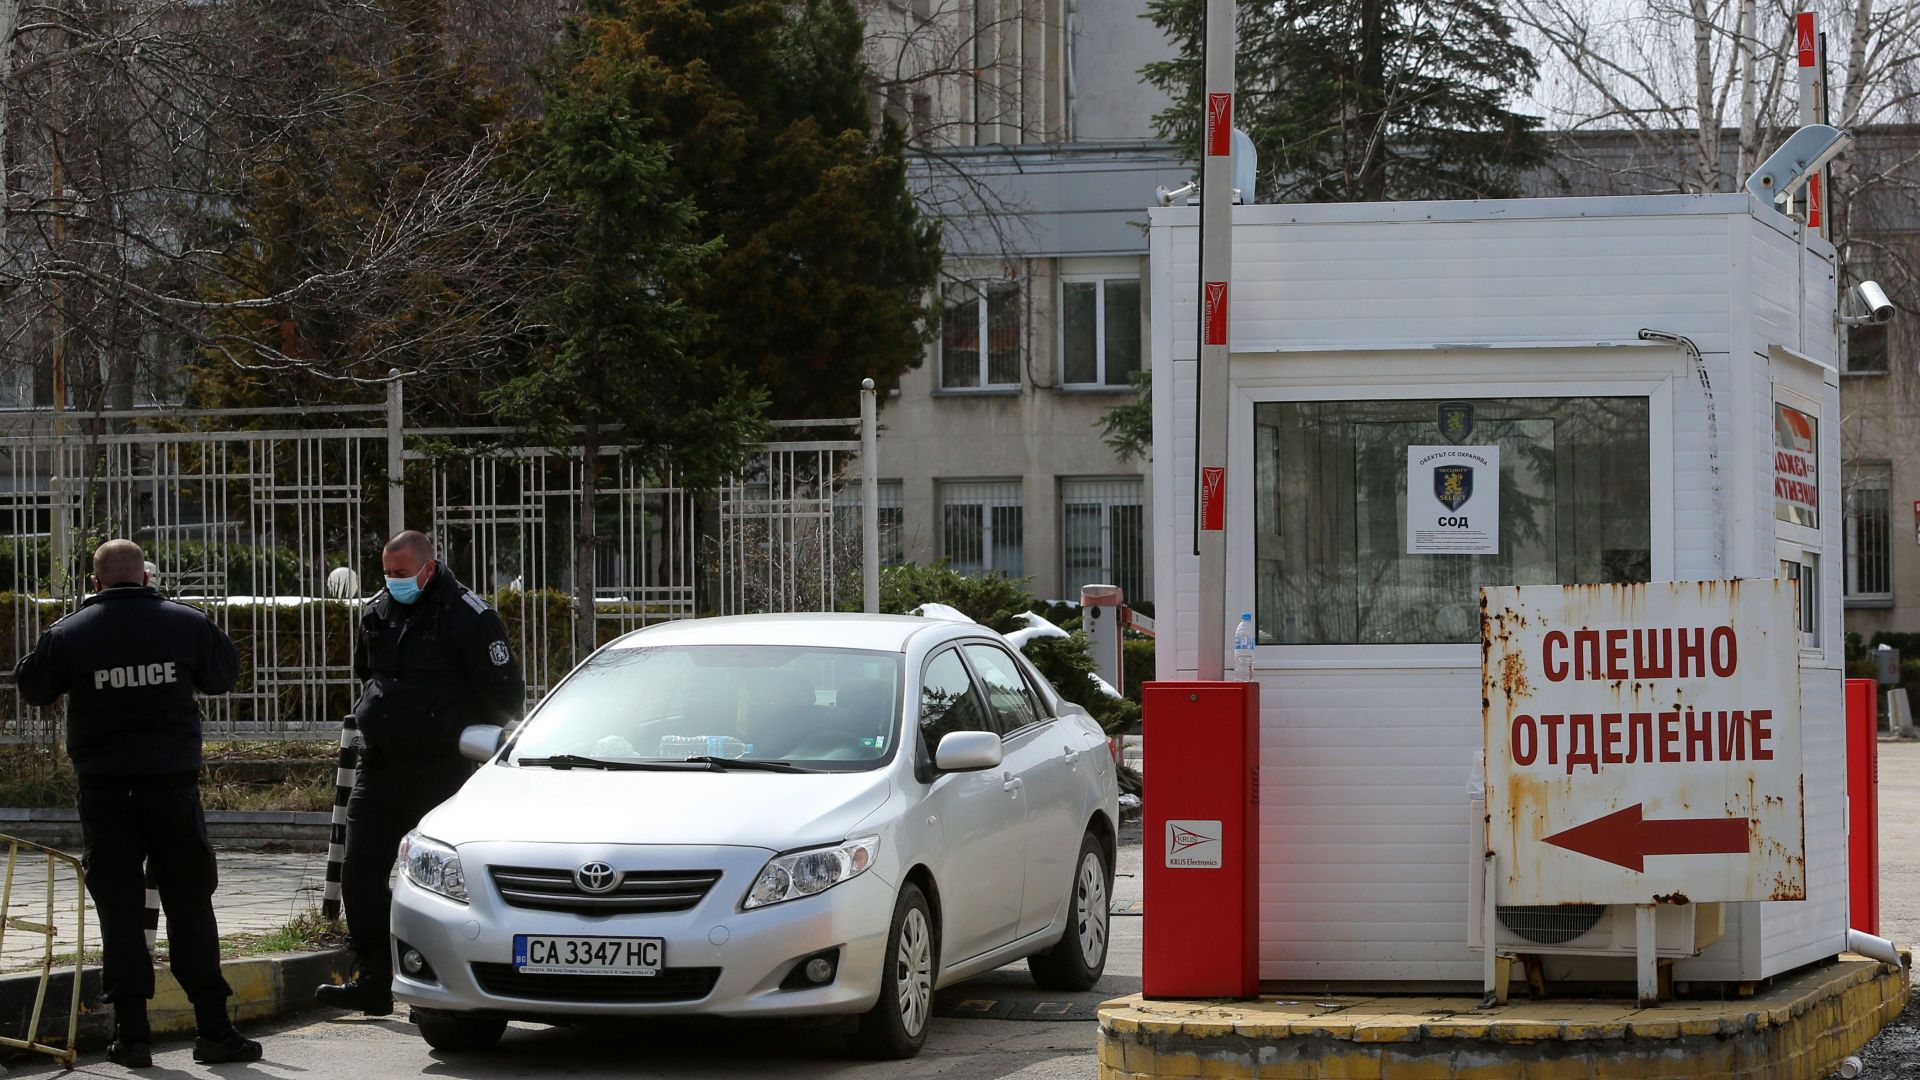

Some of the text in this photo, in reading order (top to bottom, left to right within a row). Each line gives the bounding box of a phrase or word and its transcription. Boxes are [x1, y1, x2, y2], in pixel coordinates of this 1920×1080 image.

[1419, 452, 1446, 466] ОБЕКТЪТ
[1457, 451, 1488, 466] ОХРАНЯВА
[1438, 516, 1469, 529] СОД
[1542, 625, 1738, 682] СПЕШНО
[94, 661, 177, 690] POLICE
[1511, 709, 1774, 775] ОТДЕЛЕНИЕ
[1170, 858, 1217, 866] KRUS Electronics
[516, 955, 526, 963] BG
[530, 940, 658, 966] CA 3347 HC
